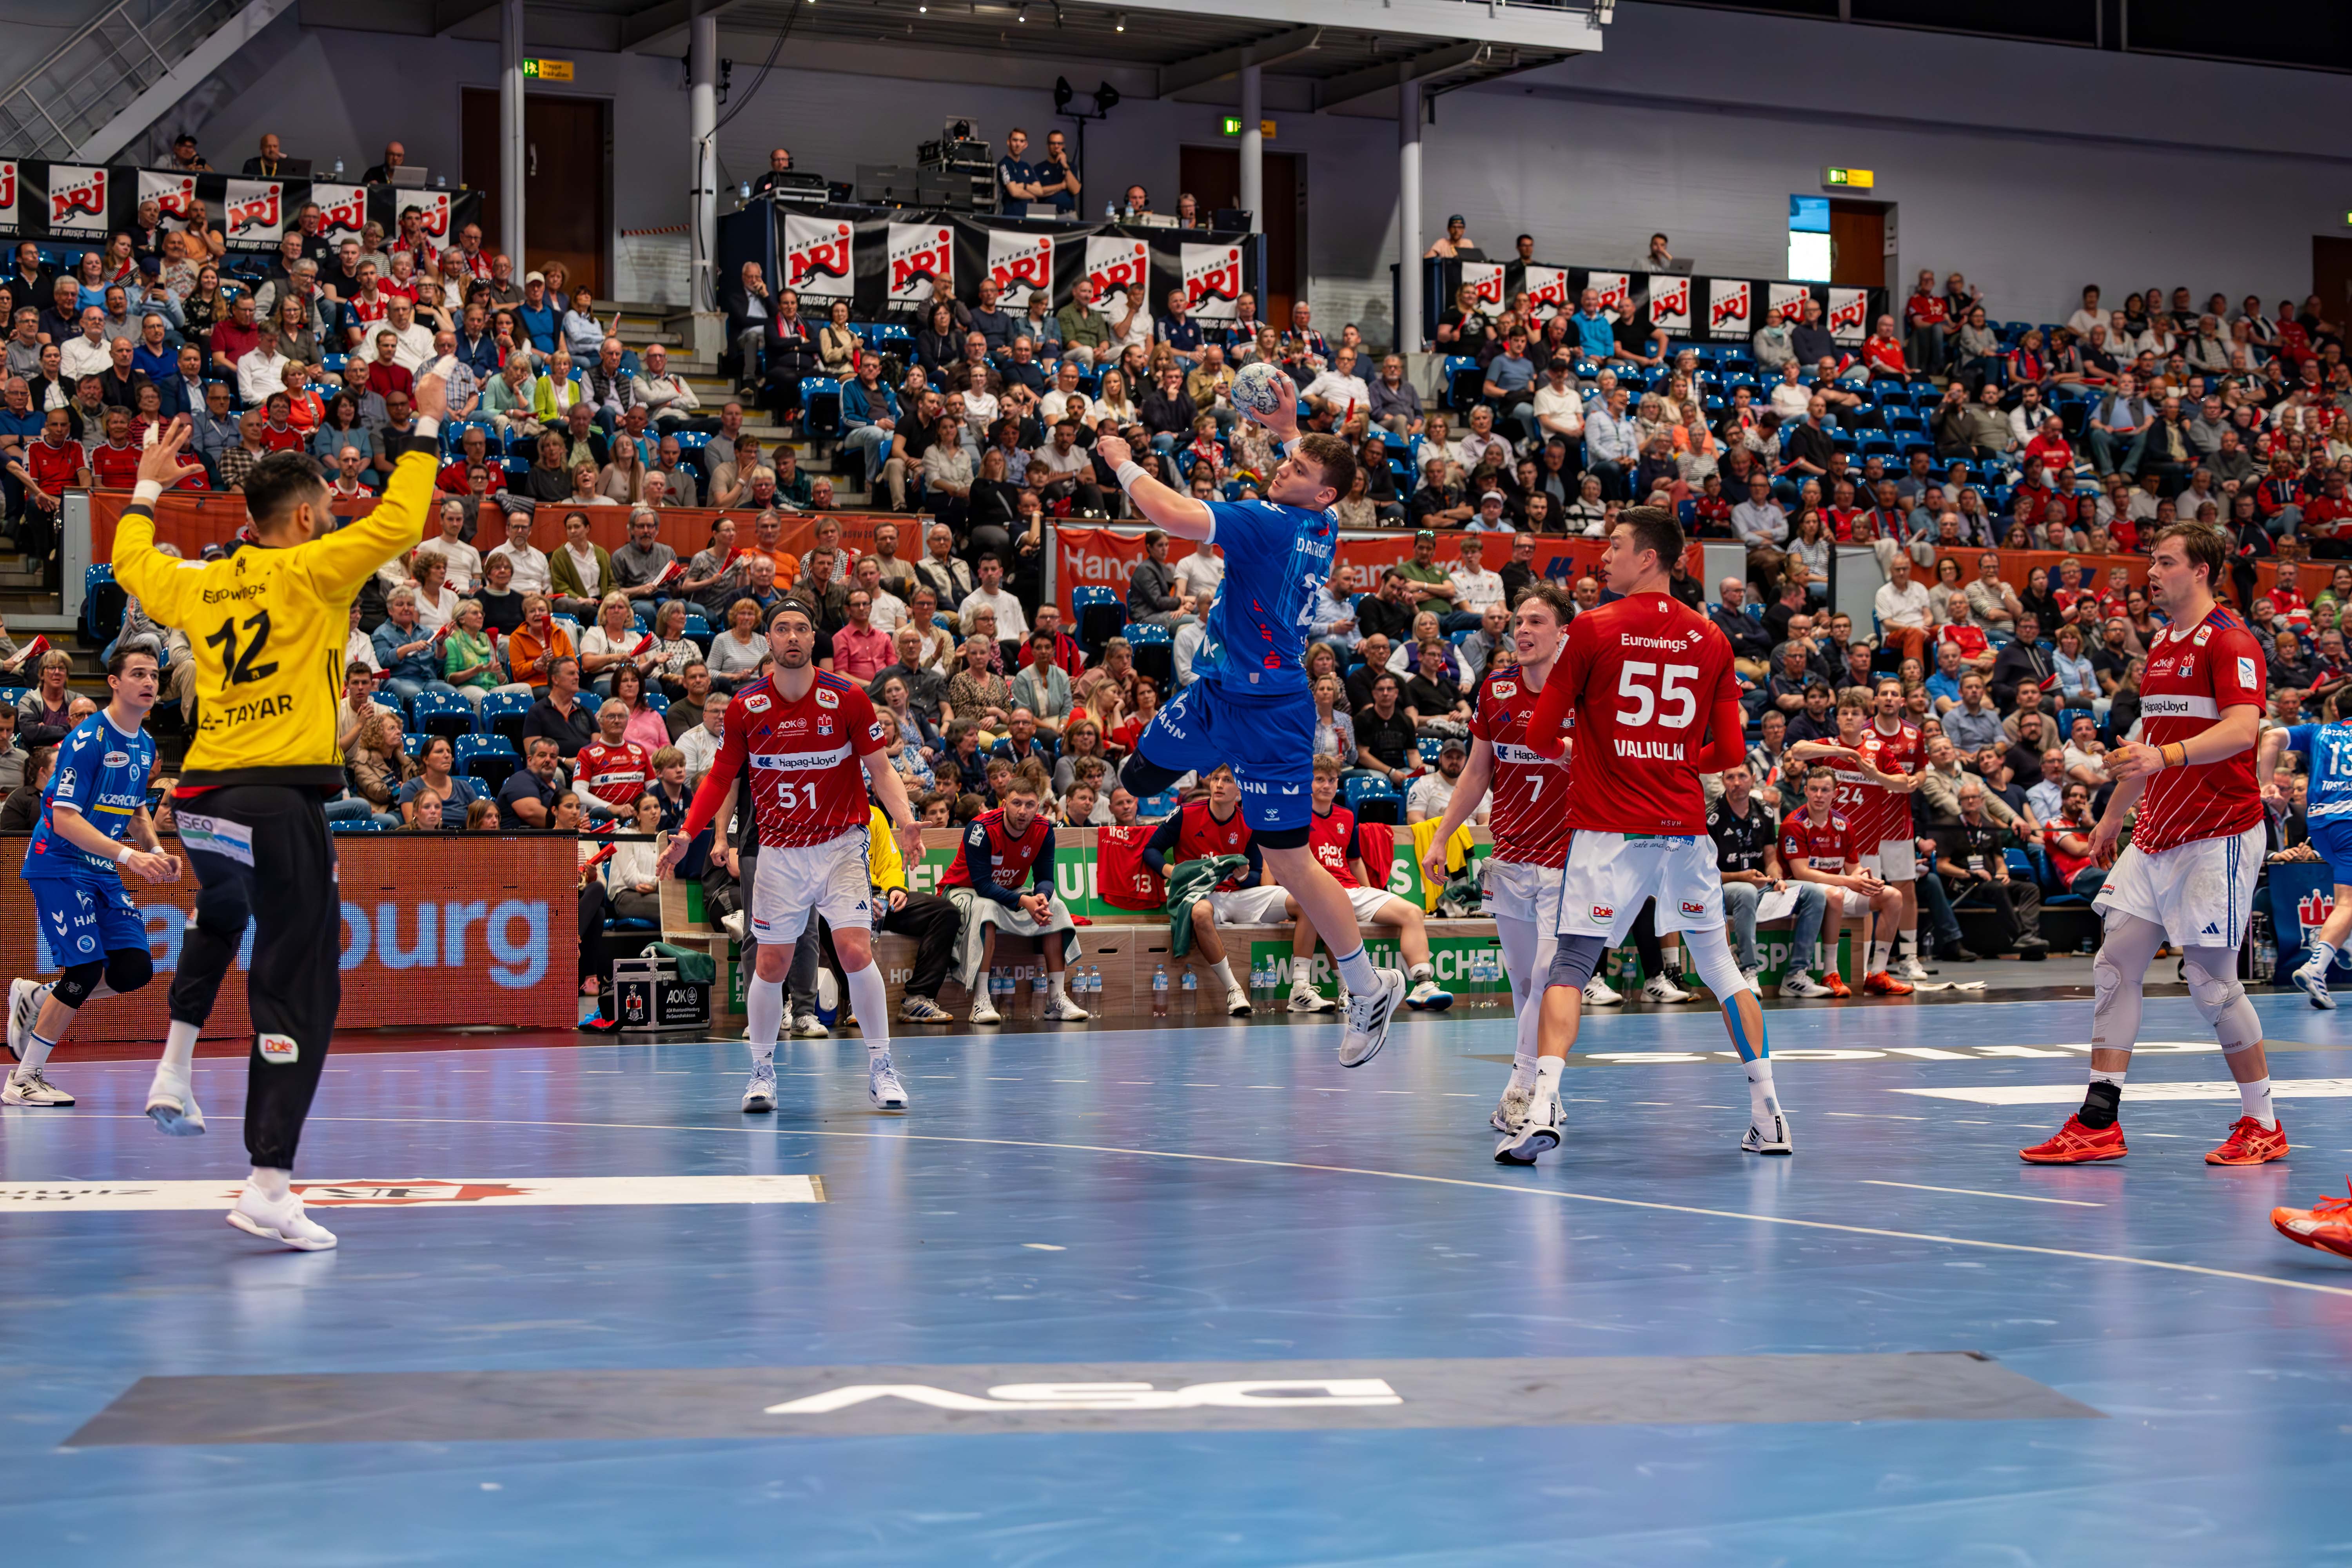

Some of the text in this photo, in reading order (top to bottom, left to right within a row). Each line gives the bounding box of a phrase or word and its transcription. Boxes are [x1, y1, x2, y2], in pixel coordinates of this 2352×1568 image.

[51, 179, 93, 195] ENERGY
[788, 233, 837, 252] ENERGY
[892, 238, 937, 259] ENERGY
[991, 246, 1038, 265] ENERGY
[1089, 252, 1133, 271] ENERGY
[800, 296, 827, 306] MUSIC
[205, 609, 279, 692] 12
[1621, 633, 1688, 653] Eurowings
[1495, 684, 1514, 693] Dole
[1615, 660, 1699, 729] 55
[748, 690, 837, 706] Dole Dole
[1517, 710, 1534, 719] AO
[2144, 700, 2188, 714] Hapag-Lloyd
[777, 719, 797, 730] AOK
[779, 755, 837, 768] Hapag-Lloyd
[778, 782, 816, 810] 51
[1524, 775, 1542, 803] 7
[1838, 786, 1864, 806] 24
[1318, 842, 1342, 859] play
[991, 867, 1020, 878] play
[1132, 874, 1152, 894] 13
[1593, 906, 1613, 916] Dole
[1682, 902, 1704, 912] Dole
[666, 989, 686, 1004] AOK
[265, 1038, 293, 1051] Dole
